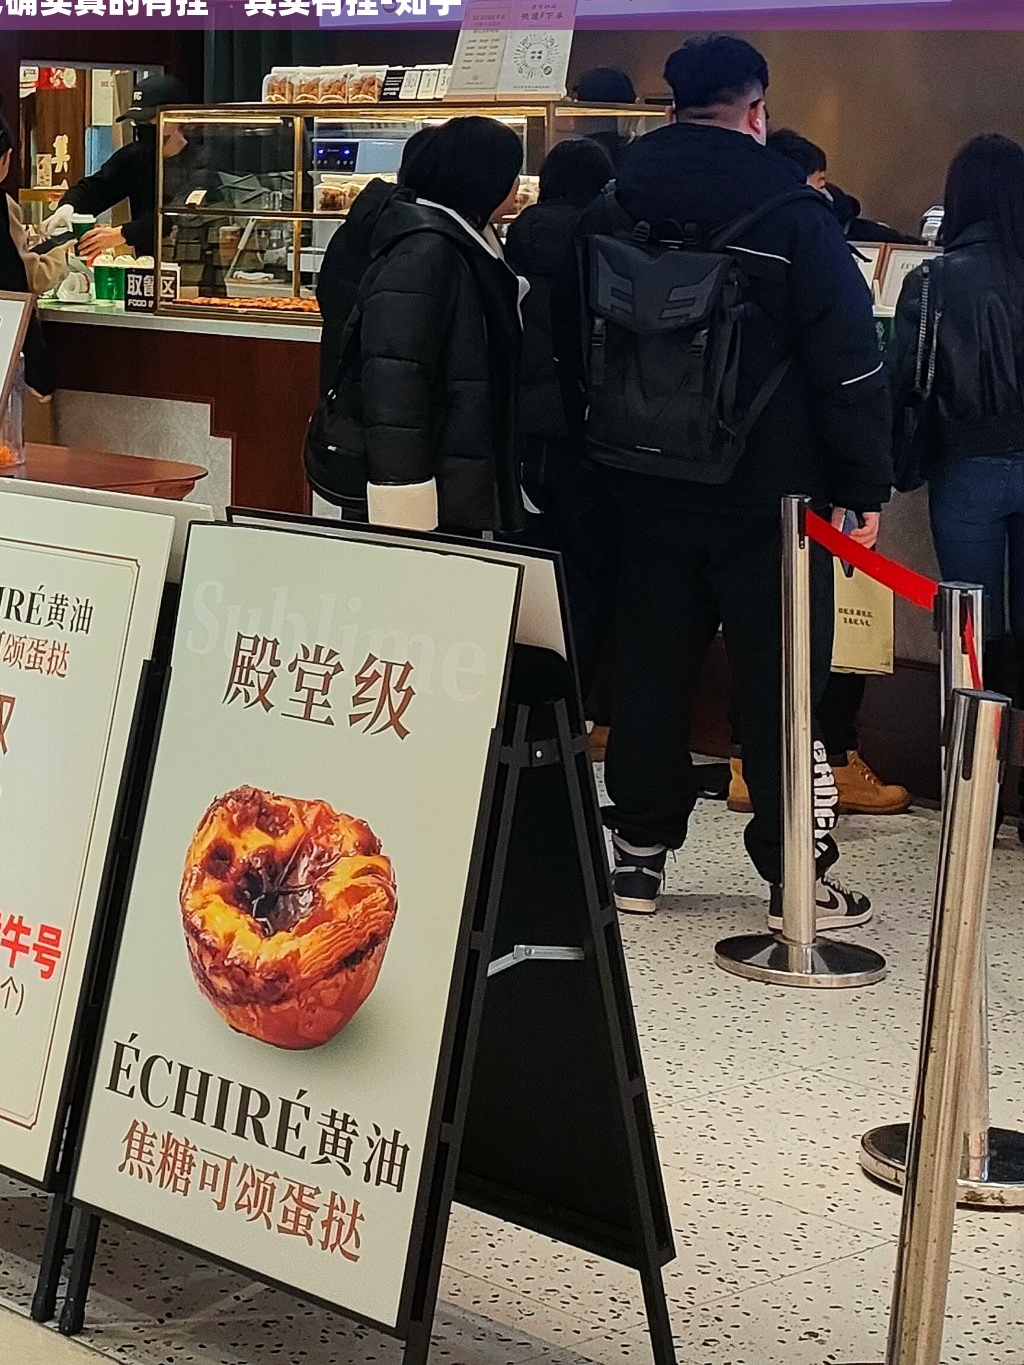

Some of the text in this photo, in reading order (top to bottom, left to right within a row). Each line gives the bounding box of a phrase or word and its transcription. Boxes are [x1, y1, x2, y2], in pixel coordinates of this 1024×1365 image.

[127, 299, 147, 307] FOOD
[187, 580, 486, 702] Sublime
[222, 630, 416, 741] 殿堂级
[117, 1118, 366, 1263] 焦糖可颂蛋挞
